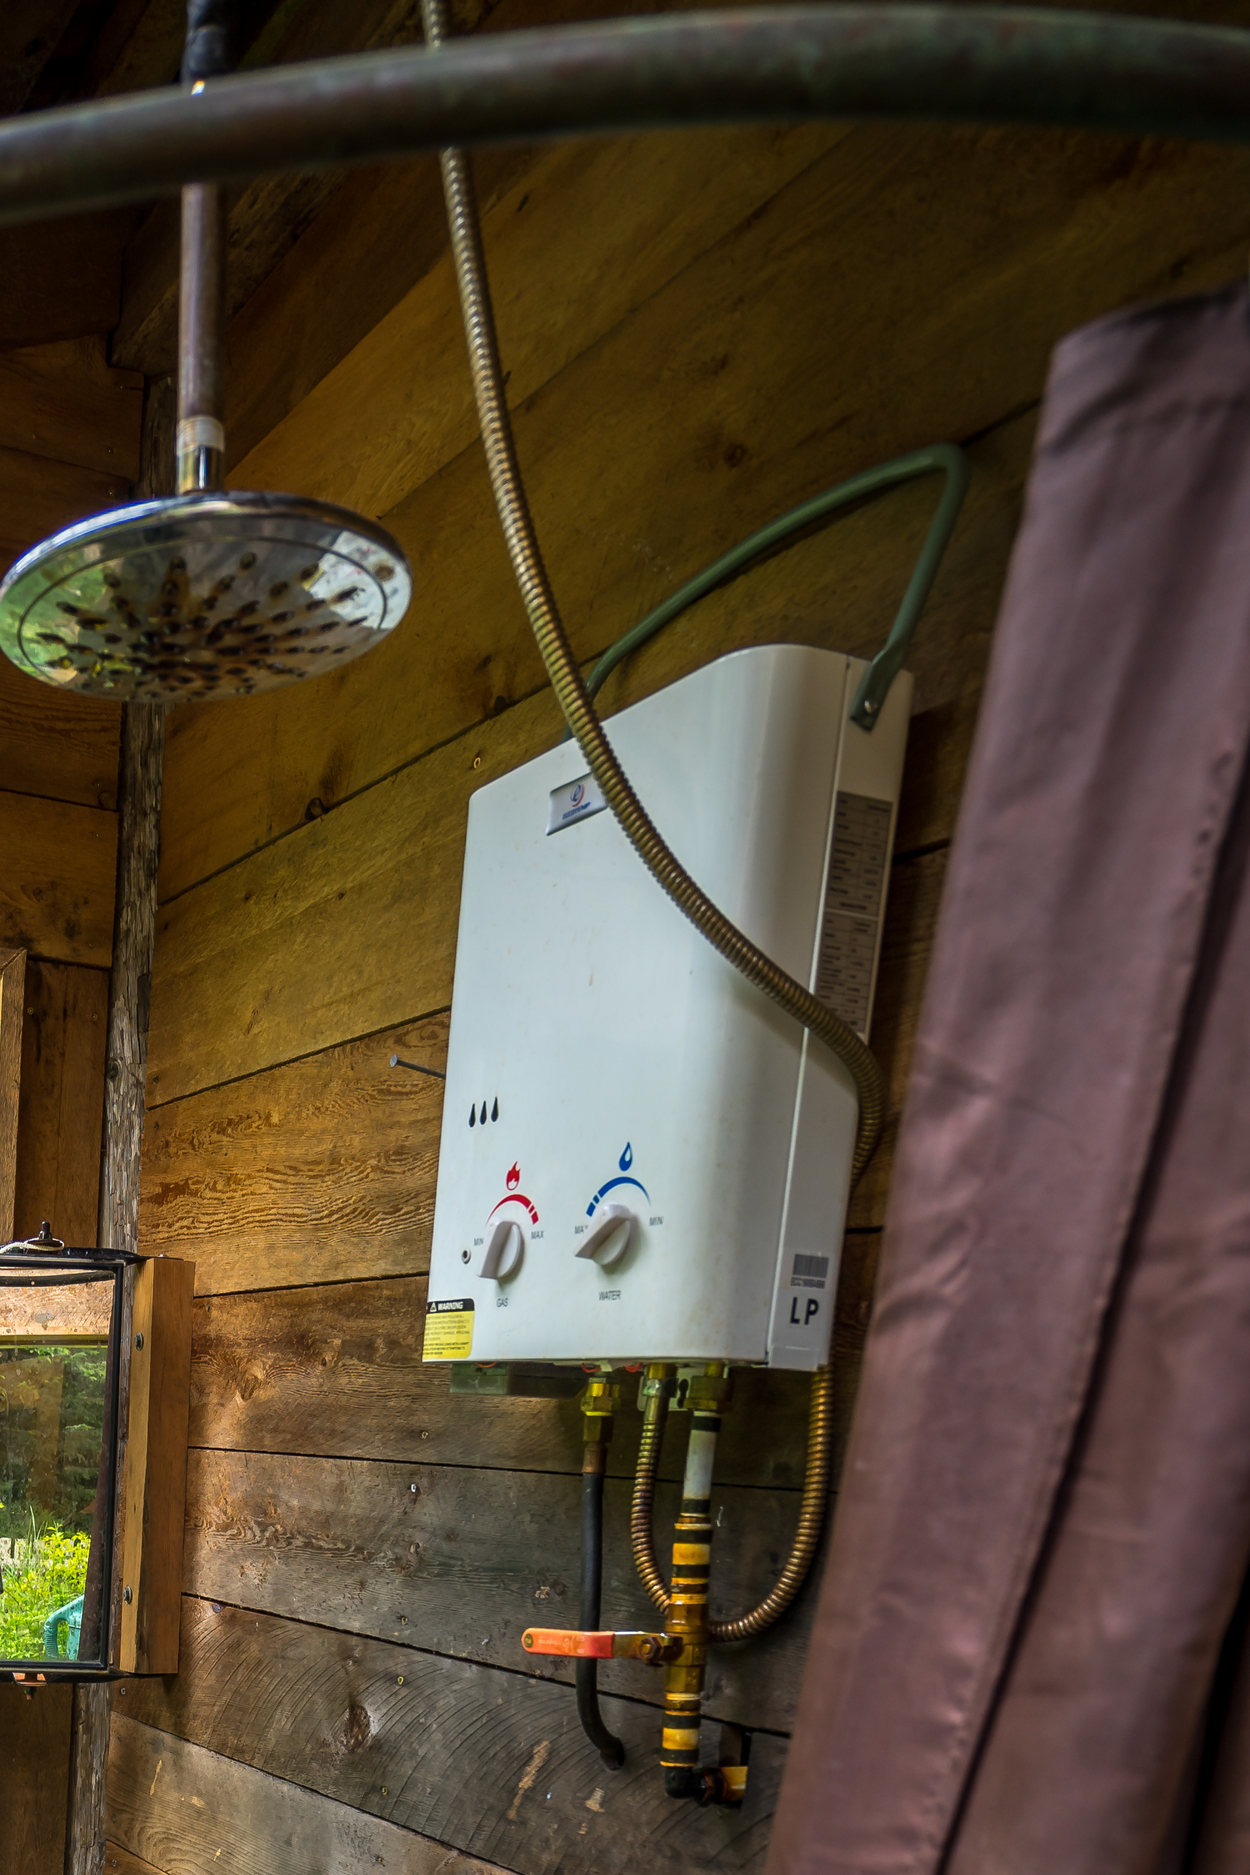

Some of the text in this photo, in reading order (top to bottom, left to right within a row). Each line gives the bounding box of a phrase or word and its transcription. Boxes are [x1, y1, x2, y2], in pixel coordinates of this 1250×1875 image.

[649, 1216, 664, 1226] MIN
[530, 1230, 545, 1240] MAX
[598, 1290, 622, 1301] WATER
[437, 1301, 464, 1311] WARNING
[496, 1297, 509, 1307] GAS
